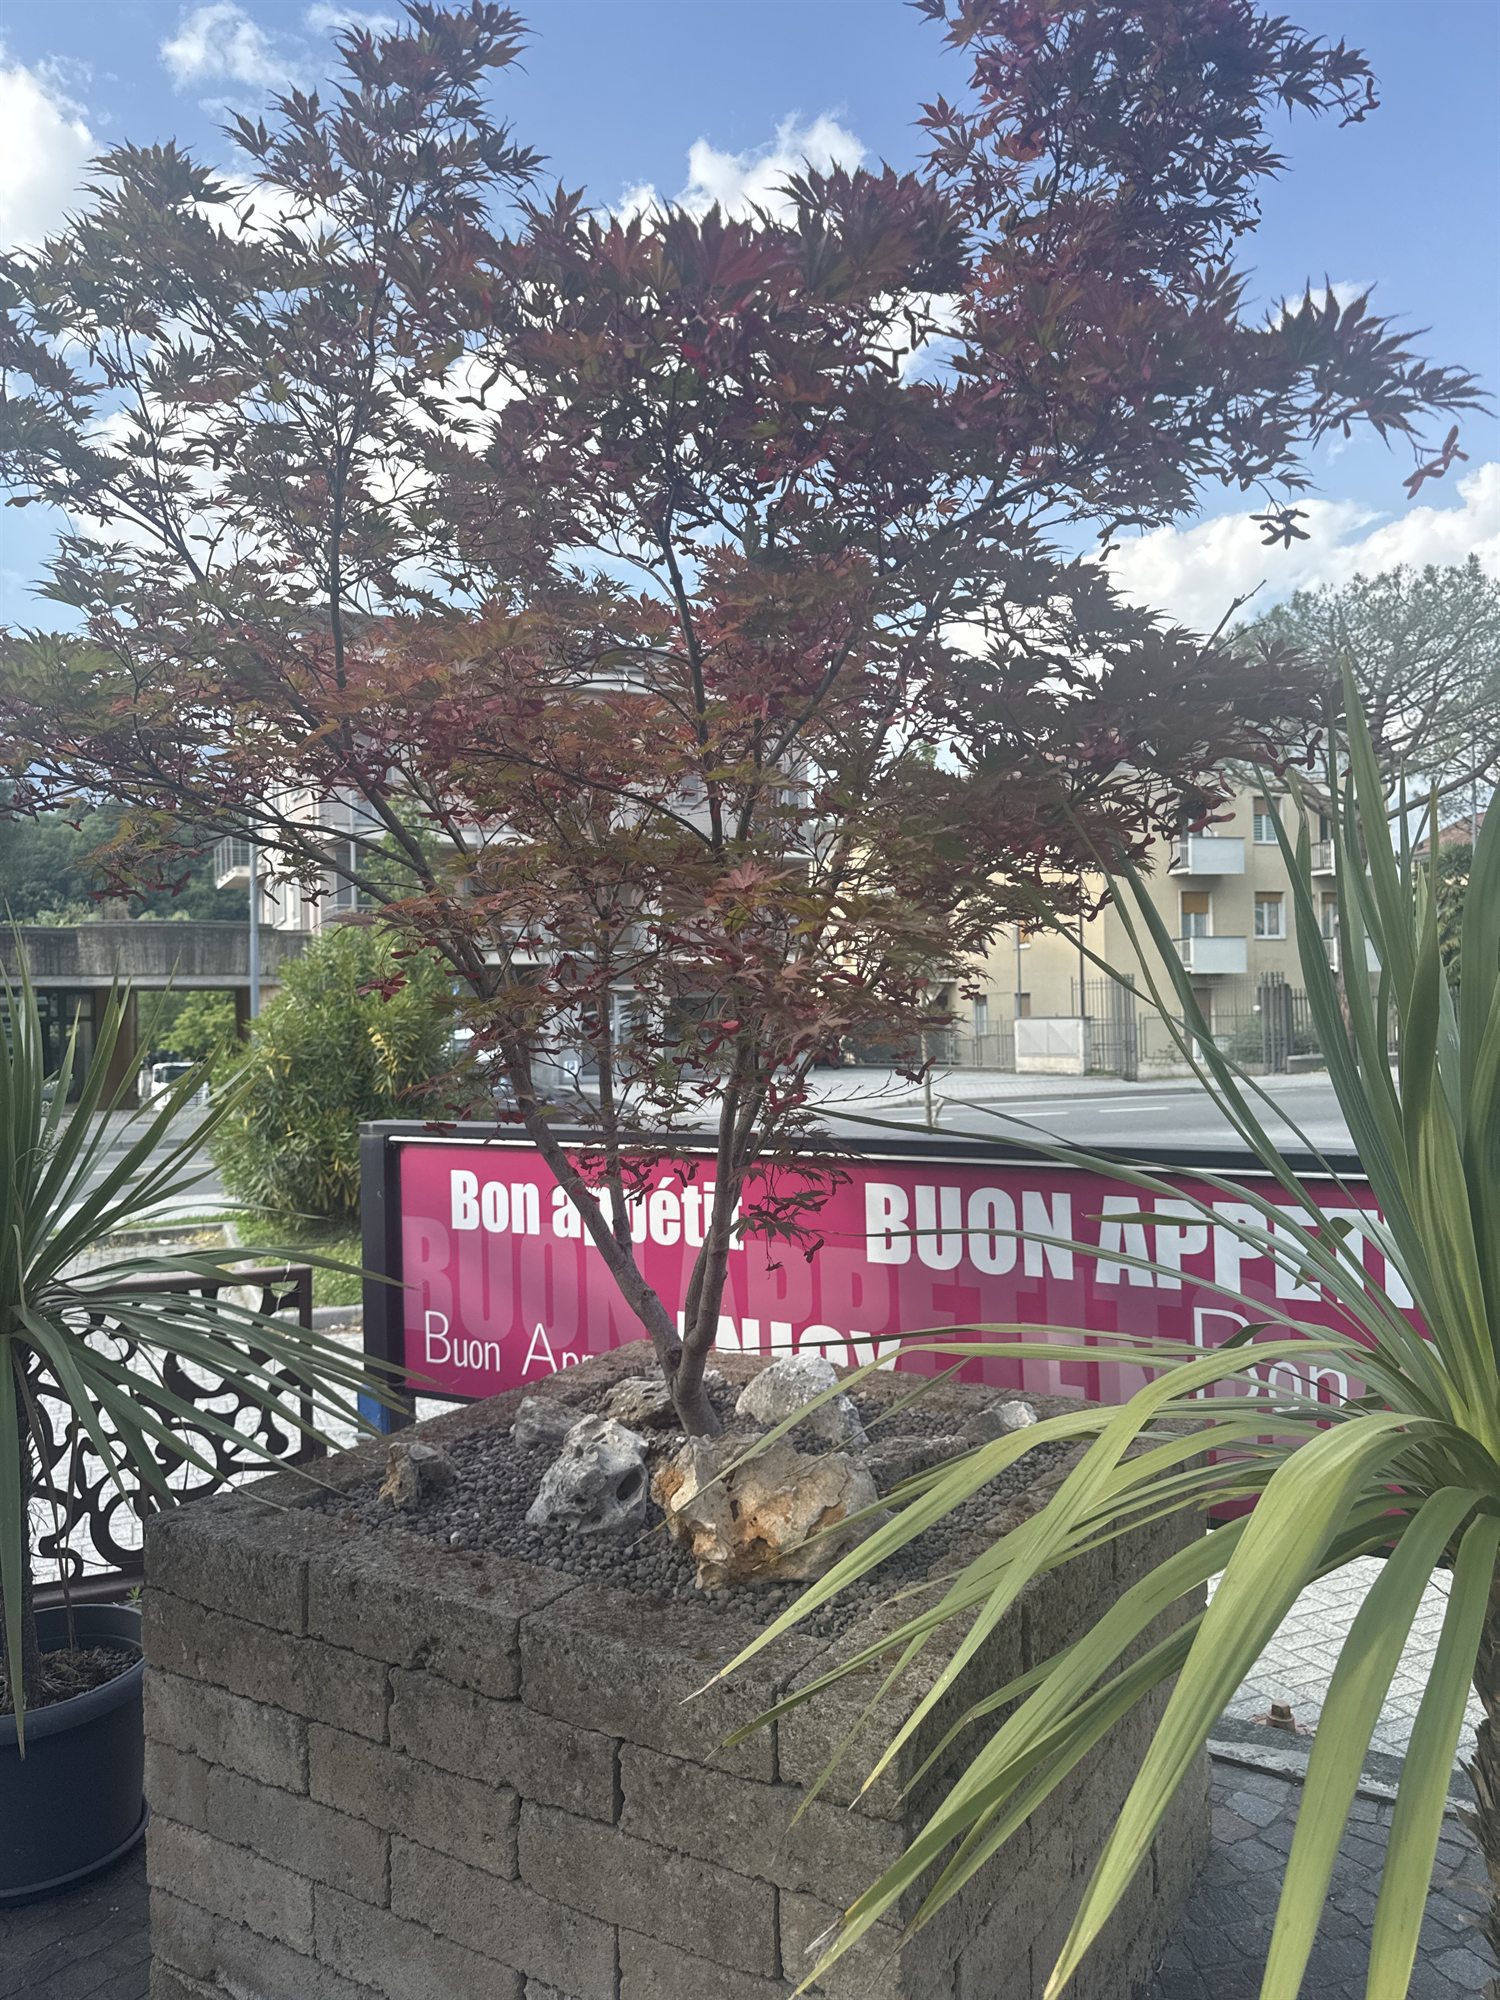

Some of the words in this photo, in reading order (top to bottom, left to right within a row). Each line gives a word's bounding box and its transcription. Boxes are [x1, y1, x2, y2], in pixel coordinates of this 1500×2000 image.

[450, 1169, 540, 1235] Bon
[865, 1182, 1074, 1281] BUON
[425, 1310, 500, 1372] Buon
